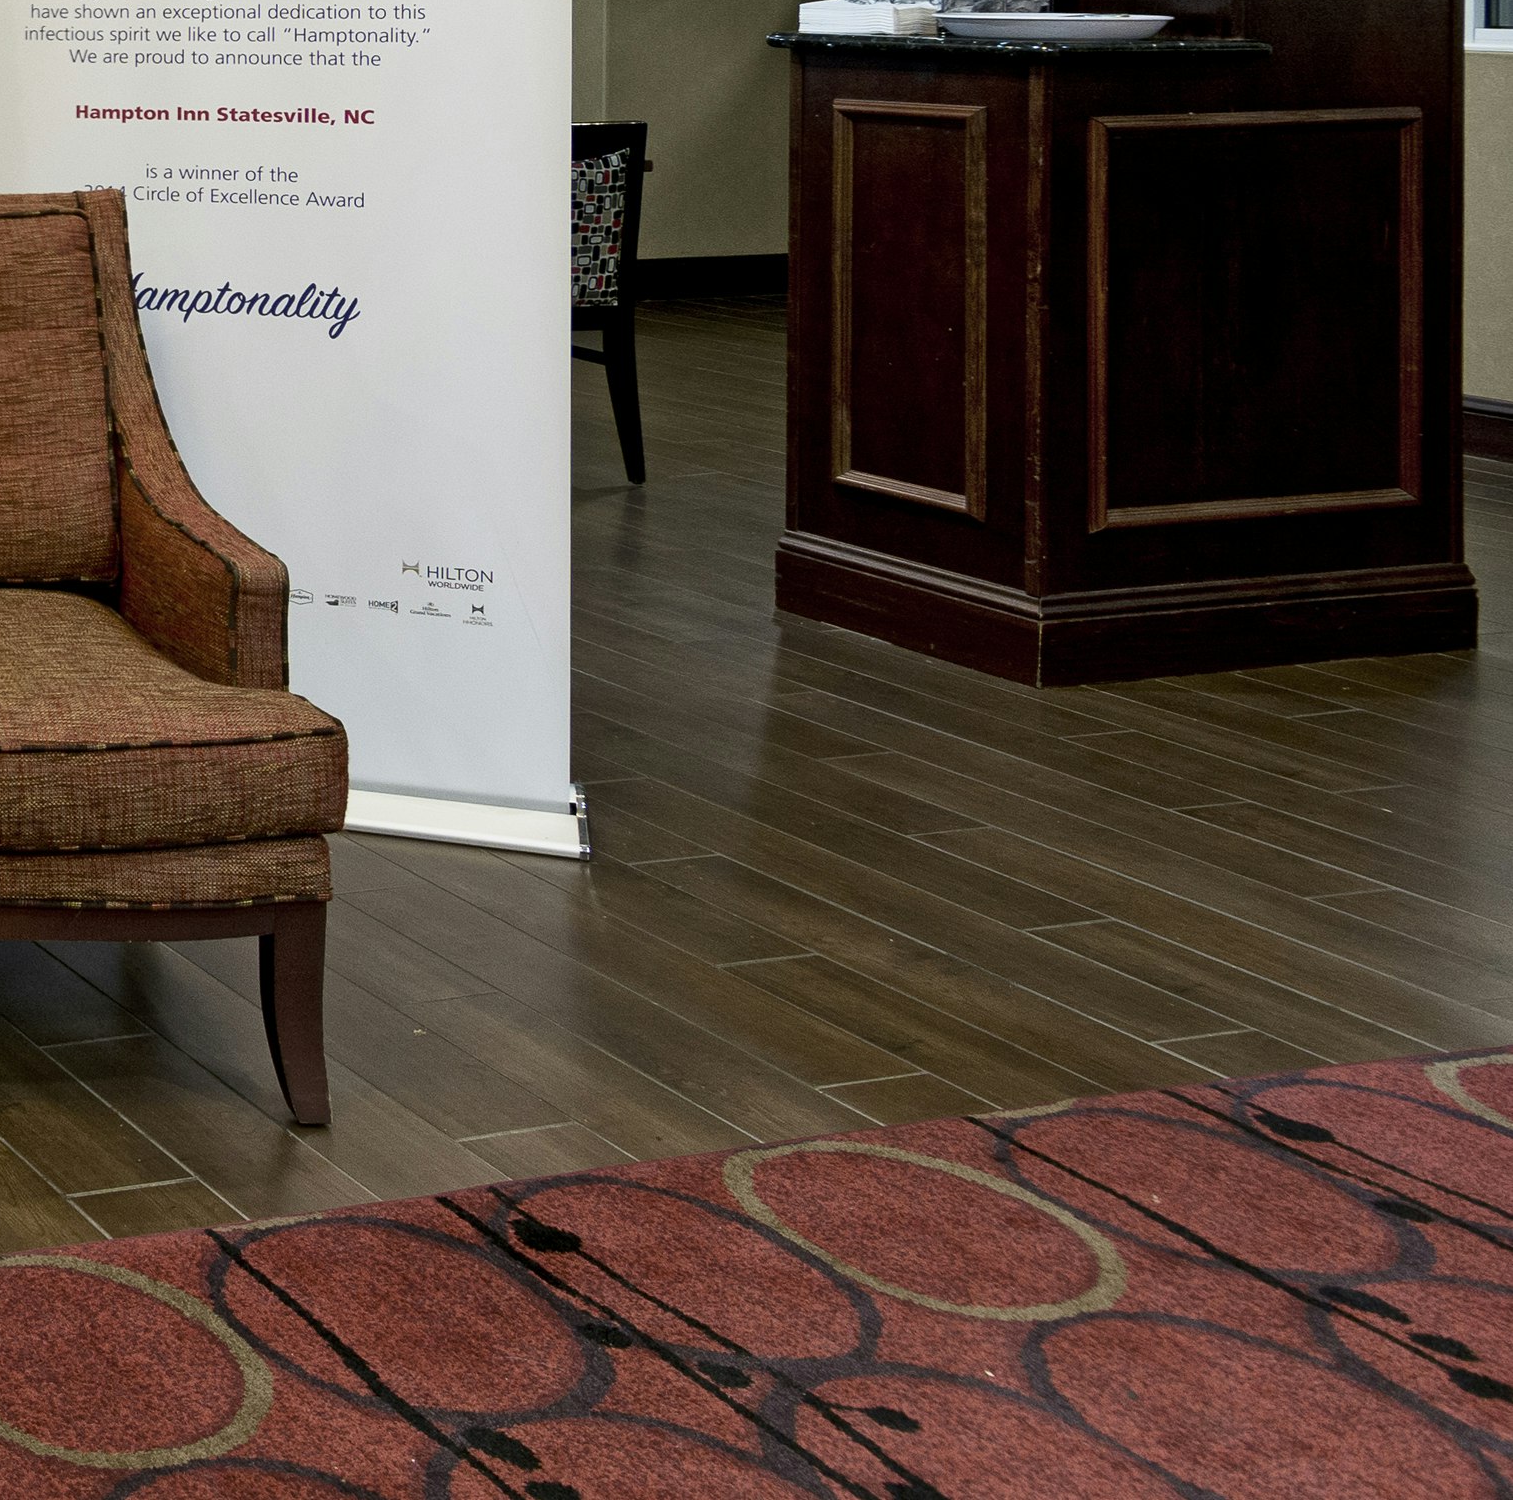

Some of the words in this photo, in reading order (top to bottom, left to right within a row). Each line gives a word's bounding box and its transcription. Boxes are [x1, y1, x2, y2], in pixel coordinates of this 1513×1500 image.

[30, 3, 70, 20] have
[74, 3, 130, 20] shown
[135, 7, 157, 20] an
[162, 3, 261, 24] exceptional
[267, 3, 361, 20] dedication
[367, 5, 387, 20] to
[392, 3, 426, 20] this
[24, 25, 105, 42] infectious
[109, 25, 151, 45] spirit
[155, 30, 182, 42] we
[187, 25, 217, 43] like
[222, 28, 242, 43] to
[246, 26, 276, 43] call
[68, 48, 98, 64] We
[102, 52, 129, 65] are
[134, 48, 185, 68] proud
[190, 50, 210, 65] to
[214, 53, 303, 66] announce
[308, 49, 346, 67] that
[351, 50, 382, 67] the
[75, 104, 170, 124] Hampton
[176, 106, 210, 122] Inn
[216, 106, 336, 126] Statesville,
[344, 109, 375, 125] NC
[145, 163, 158, 179] is
[163, 167, 173, 180] a
[178, 164, 240, 182] winner
[245, 165, 265, 182] of
[268, 166, 299, 184] the
[132, 185, 181, 202] Circle
[185, 187, 205, 202] of
[210, 188, 300, 206] Excellence
[305, 191, 365, 208] Award
[131, 272, 362, 339] amptonality
[426, 565, 494, 584] HILTON
[427, 580, 485, 592] WORLDWIDE
